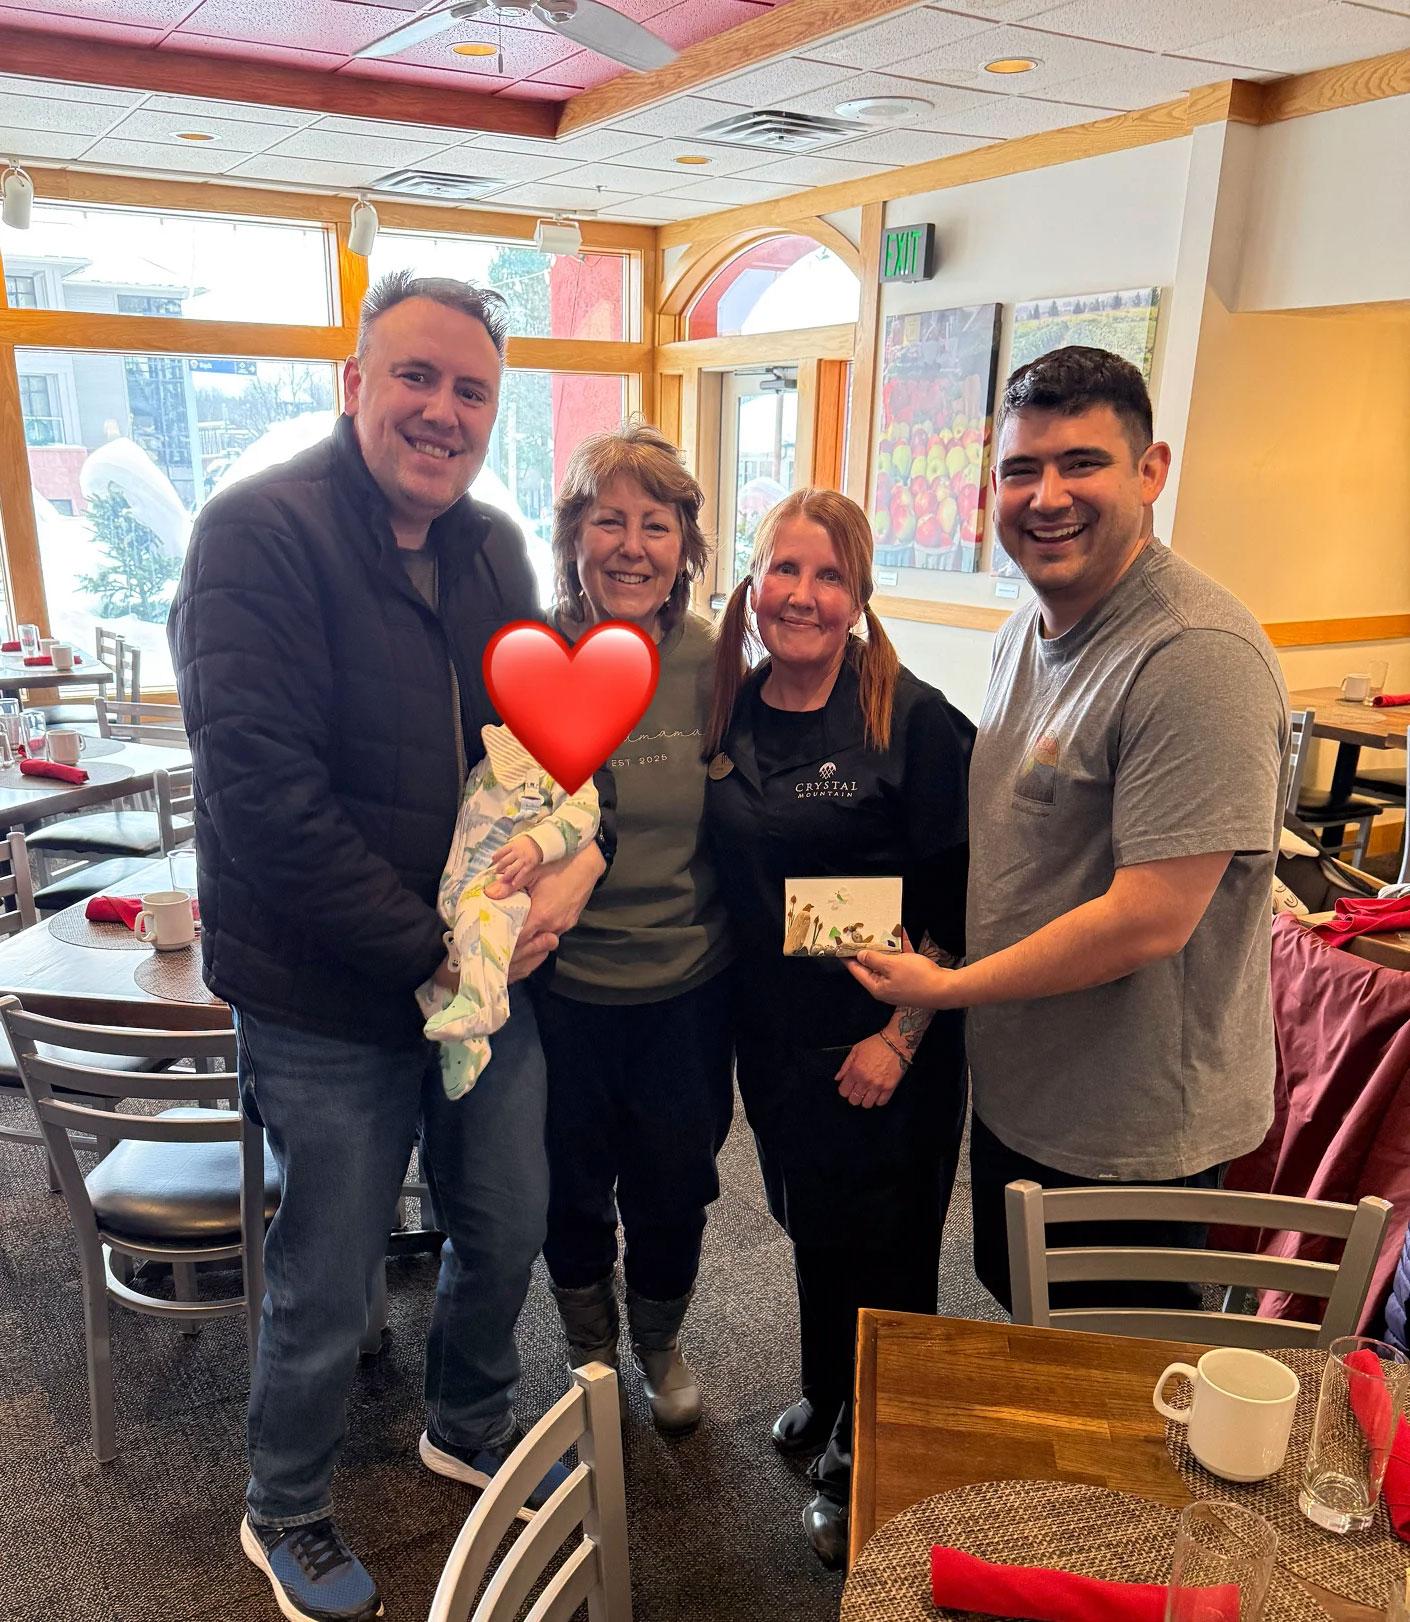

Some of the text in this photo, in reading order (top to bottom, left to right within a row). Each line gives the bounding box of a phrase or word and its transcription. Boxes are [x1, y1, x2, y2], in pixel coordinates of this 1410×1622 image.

[884, 230, 922, 277] EXIT
[611, 753, 668, 767] EST 2025
[795, 780, 858, 792] CRYSTAL
[797, 791, 853, 799] MOUNTAIN
